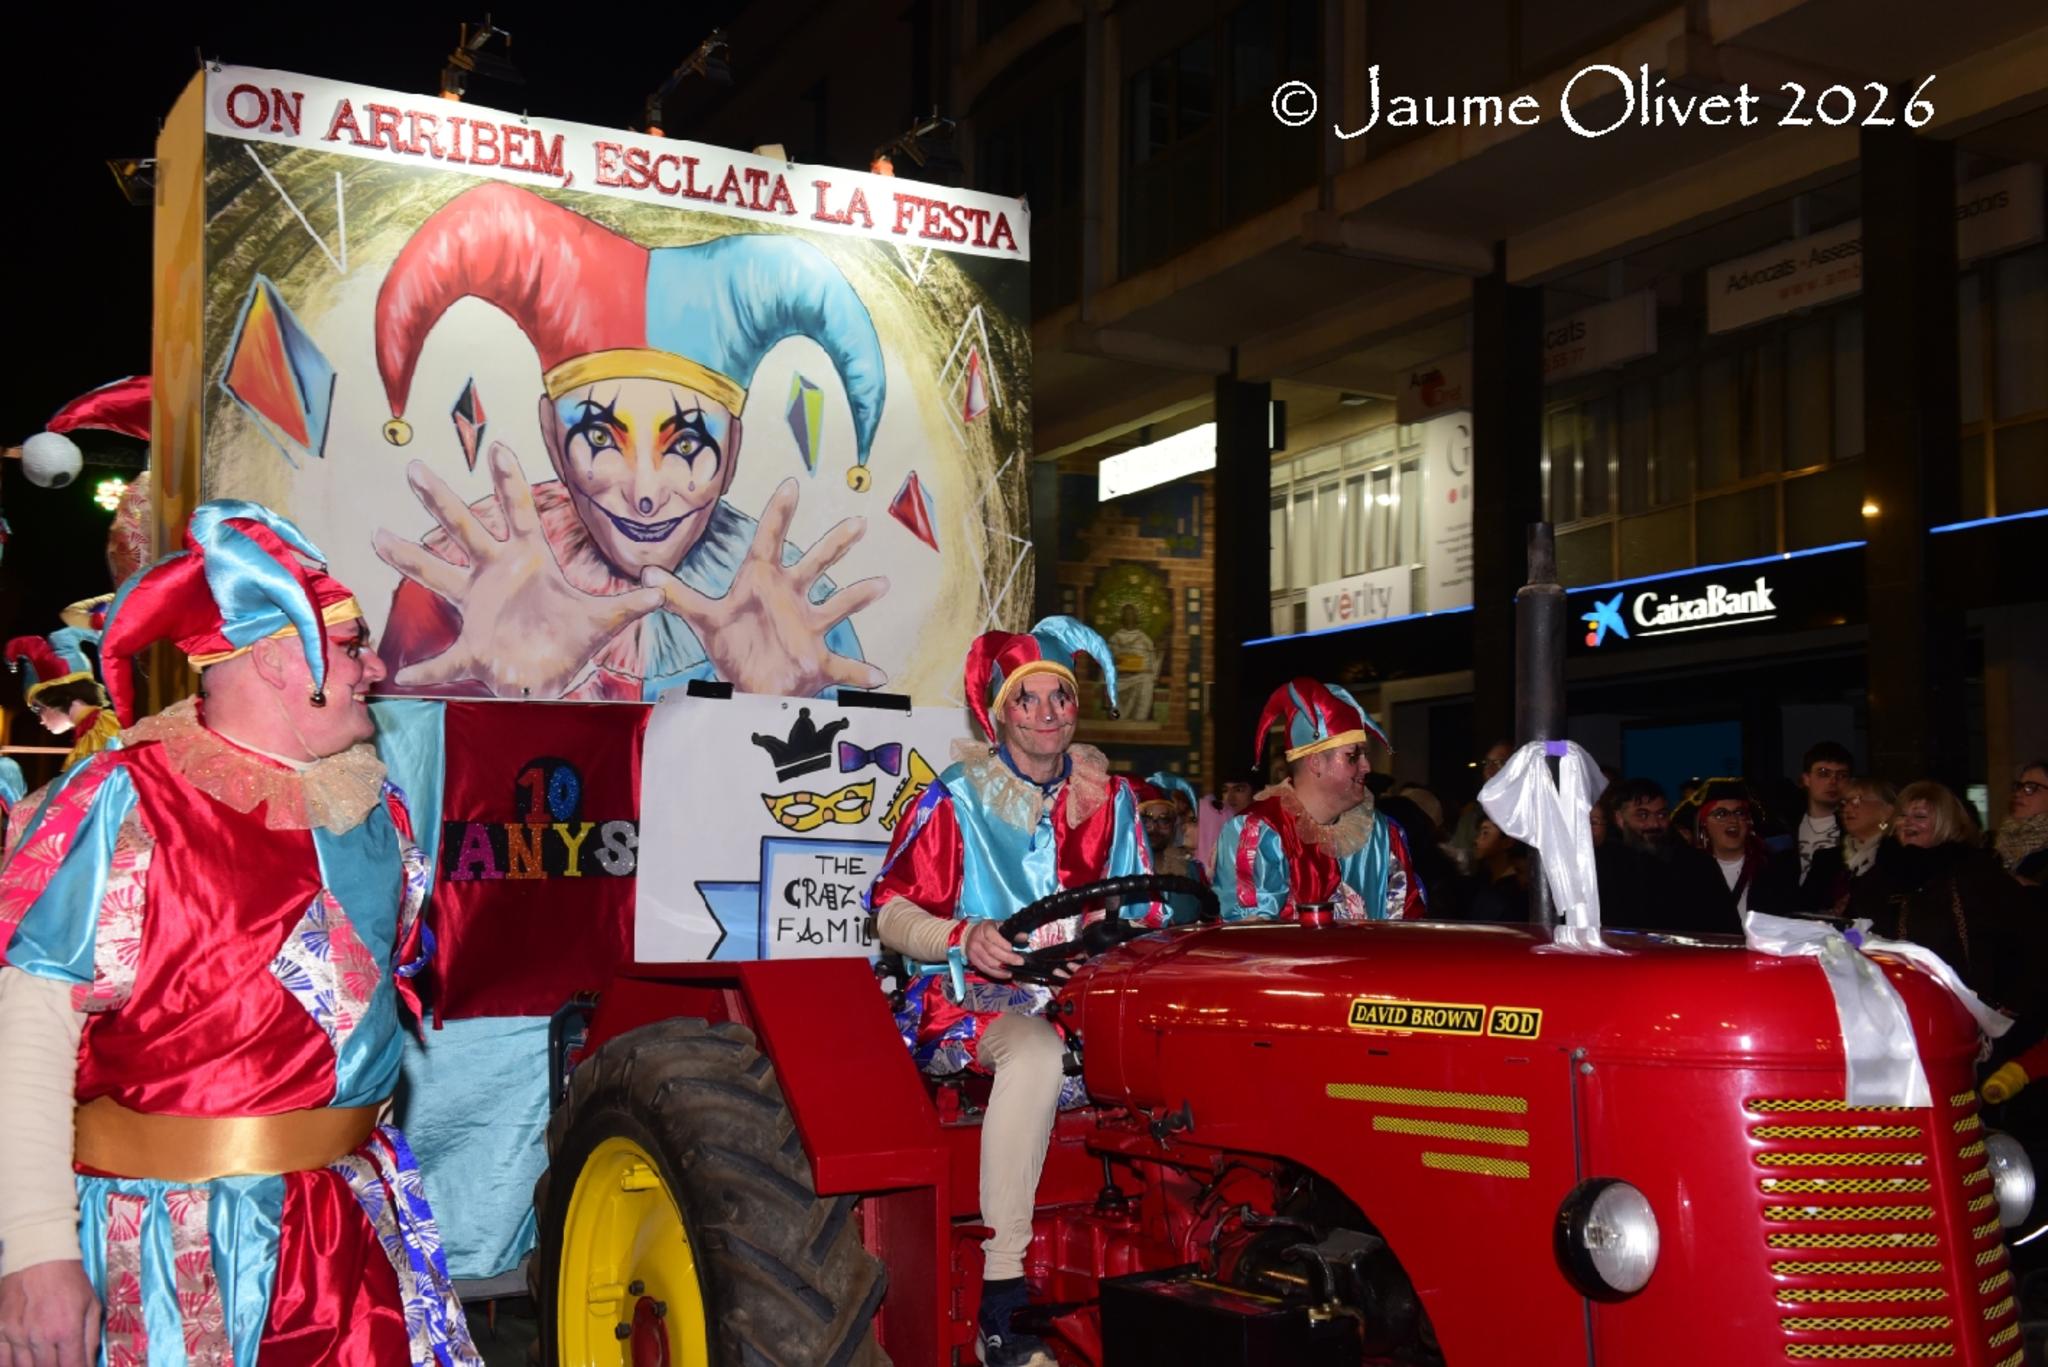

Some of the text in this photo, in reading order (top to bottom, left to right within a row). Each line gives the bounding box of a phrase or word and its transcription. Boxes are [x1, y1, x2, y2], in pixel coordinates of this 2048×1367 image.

[225, 83, 1018, 251] ON ARRIBEM, ESCLATA LA FESTA
[1546, 320, 1586, 350] cats
[1633, 576, 1777, 628] CaixaBank
[517, 764, 581, 823] 10
[450, 820, 639, 881] ANYS
[815, 855, 867, 875] THE
[784, 877, 864, 911] CRAZ
[1355, 1004, 1407, 1025] DAVID
[1411, 1008, 1479, 1029] BROWN
